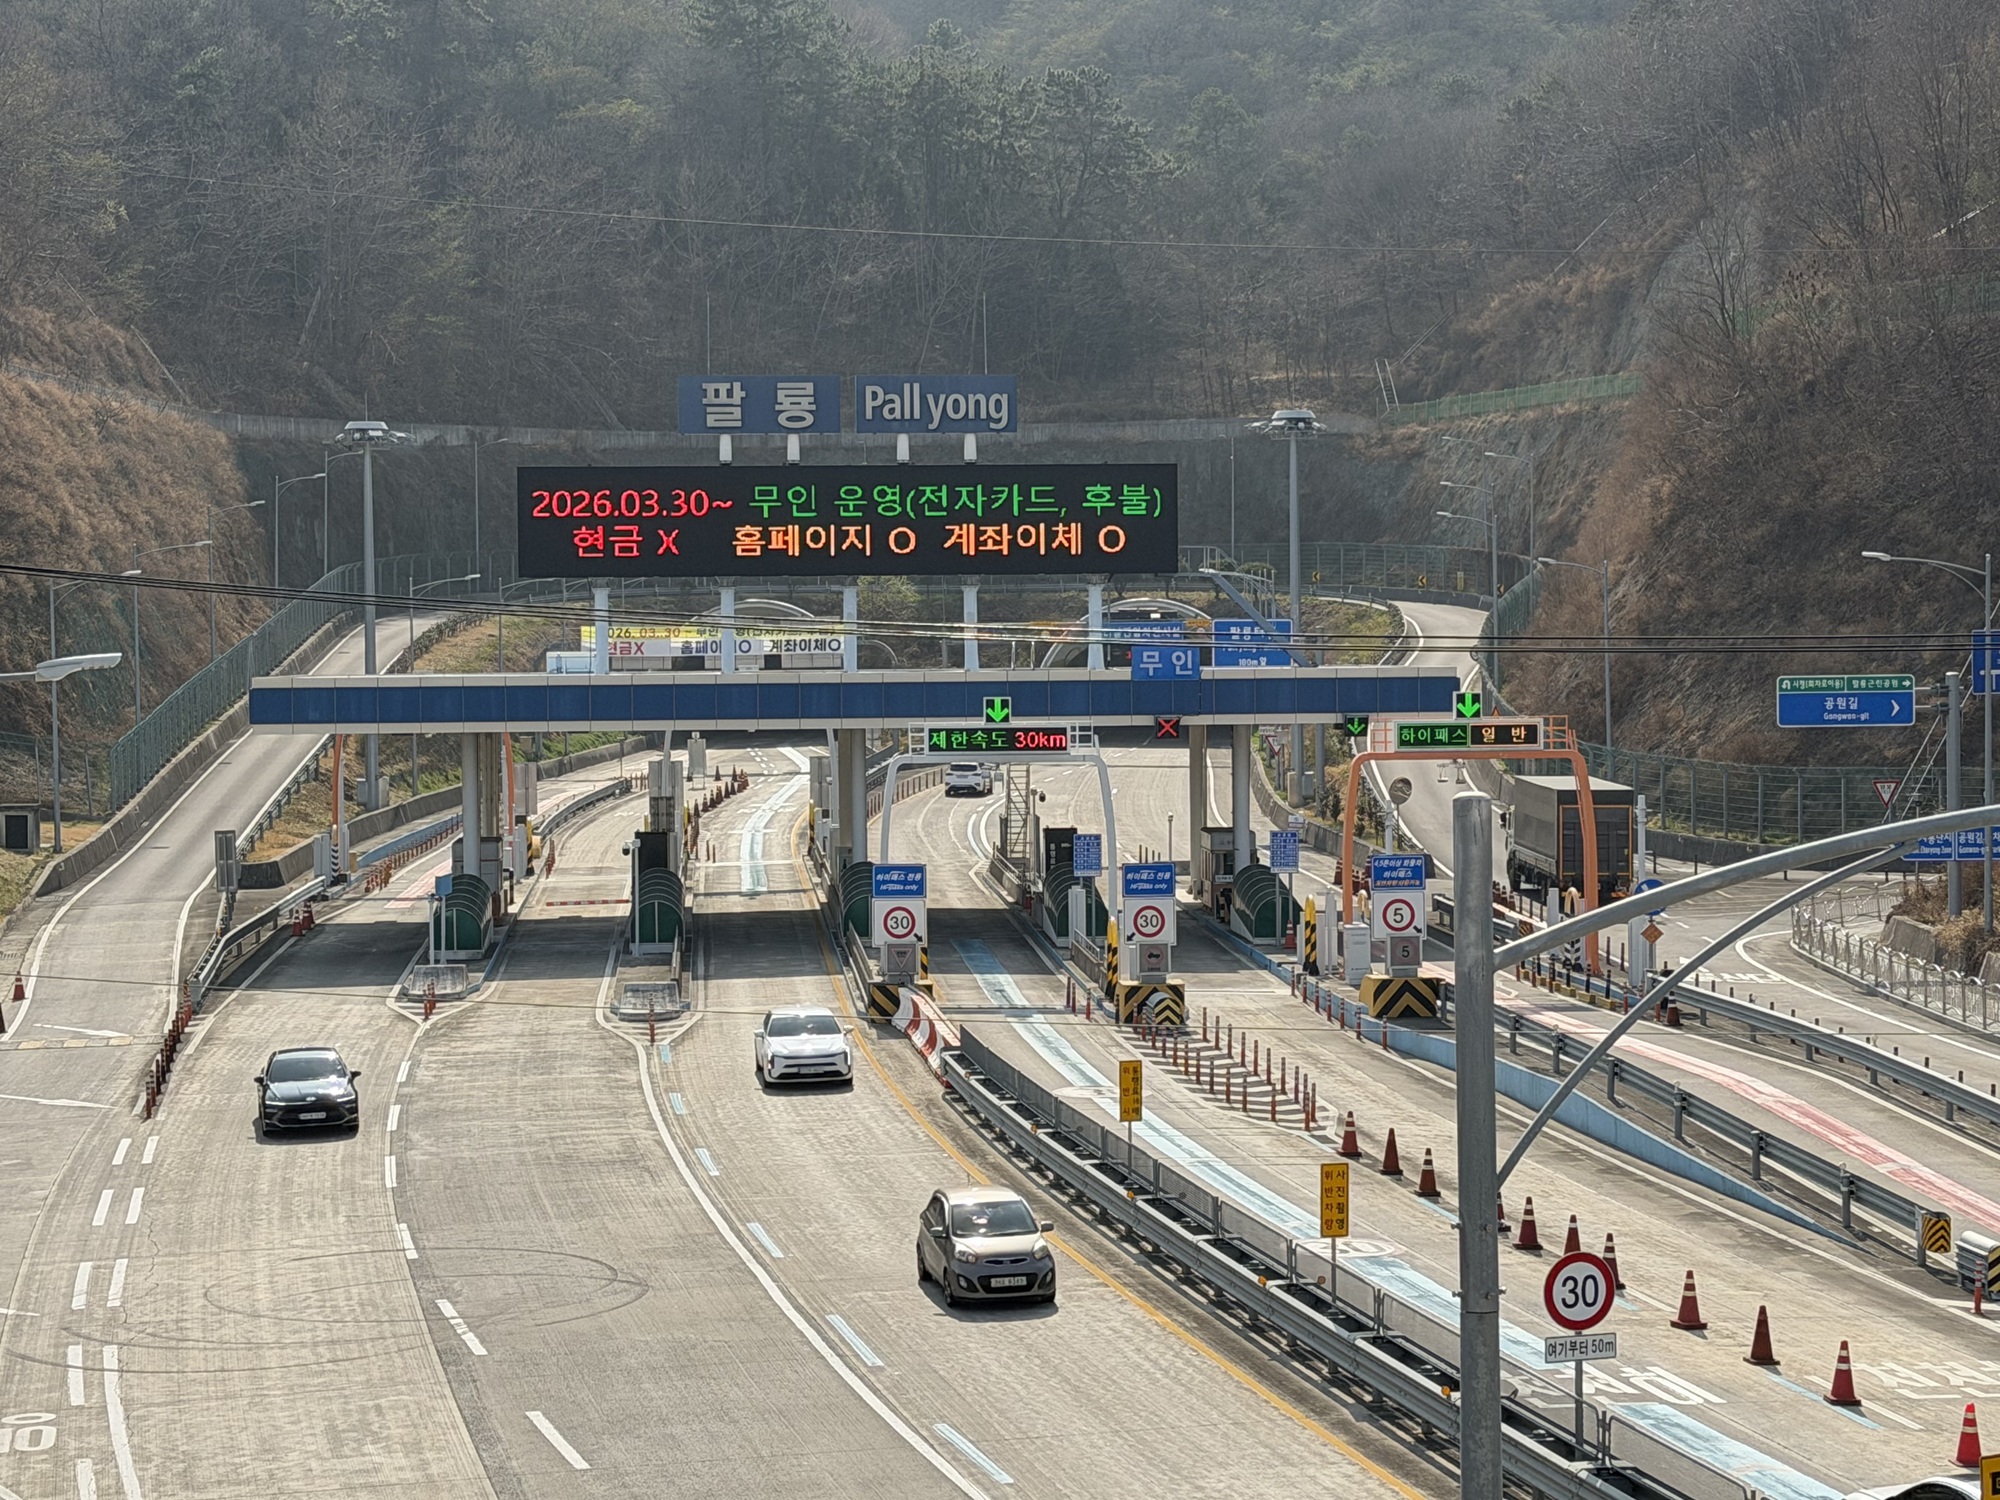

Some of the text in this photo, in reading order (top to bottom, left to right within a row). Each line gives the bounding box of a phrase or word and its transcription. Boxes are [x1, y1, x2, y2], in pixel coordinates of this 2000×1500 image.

[749, 485, 817, 519] 무인
[834, 484, 1067, 519] 운영(전자카드,
[1082, 484, 1162, 518] 후불)
[573, 522, 1126, 557] 현금 X 홈페이지 O 계좌이체 O
[1823, 697, 1859, 710] 공원길
[929, 731, 1067, 750] 제한속도 30km
[1400, 727, 1468, 744] 하이패스
[876, 871, 922, 882] 하이패스 전용
[1126, 870, 1171, 881] 하이패스 전용
[904, 884, 919, 892] only
[1154, 882, 1168, 890] only
[889, 915, 910, 930] 30
[1139, 914, 1159, 928] 30
[1393, 907, 1404, 924] 5
[1401, 945, 1410, 958] 5
[1324, 1170, 1334, 1231] 위반차량
[1335, 1170, 1345, 1230] 사진촬영
[1561, 1274, 1599, 1309] 30
[1547, 1338, 1615, 1359] 여기부터 50m
